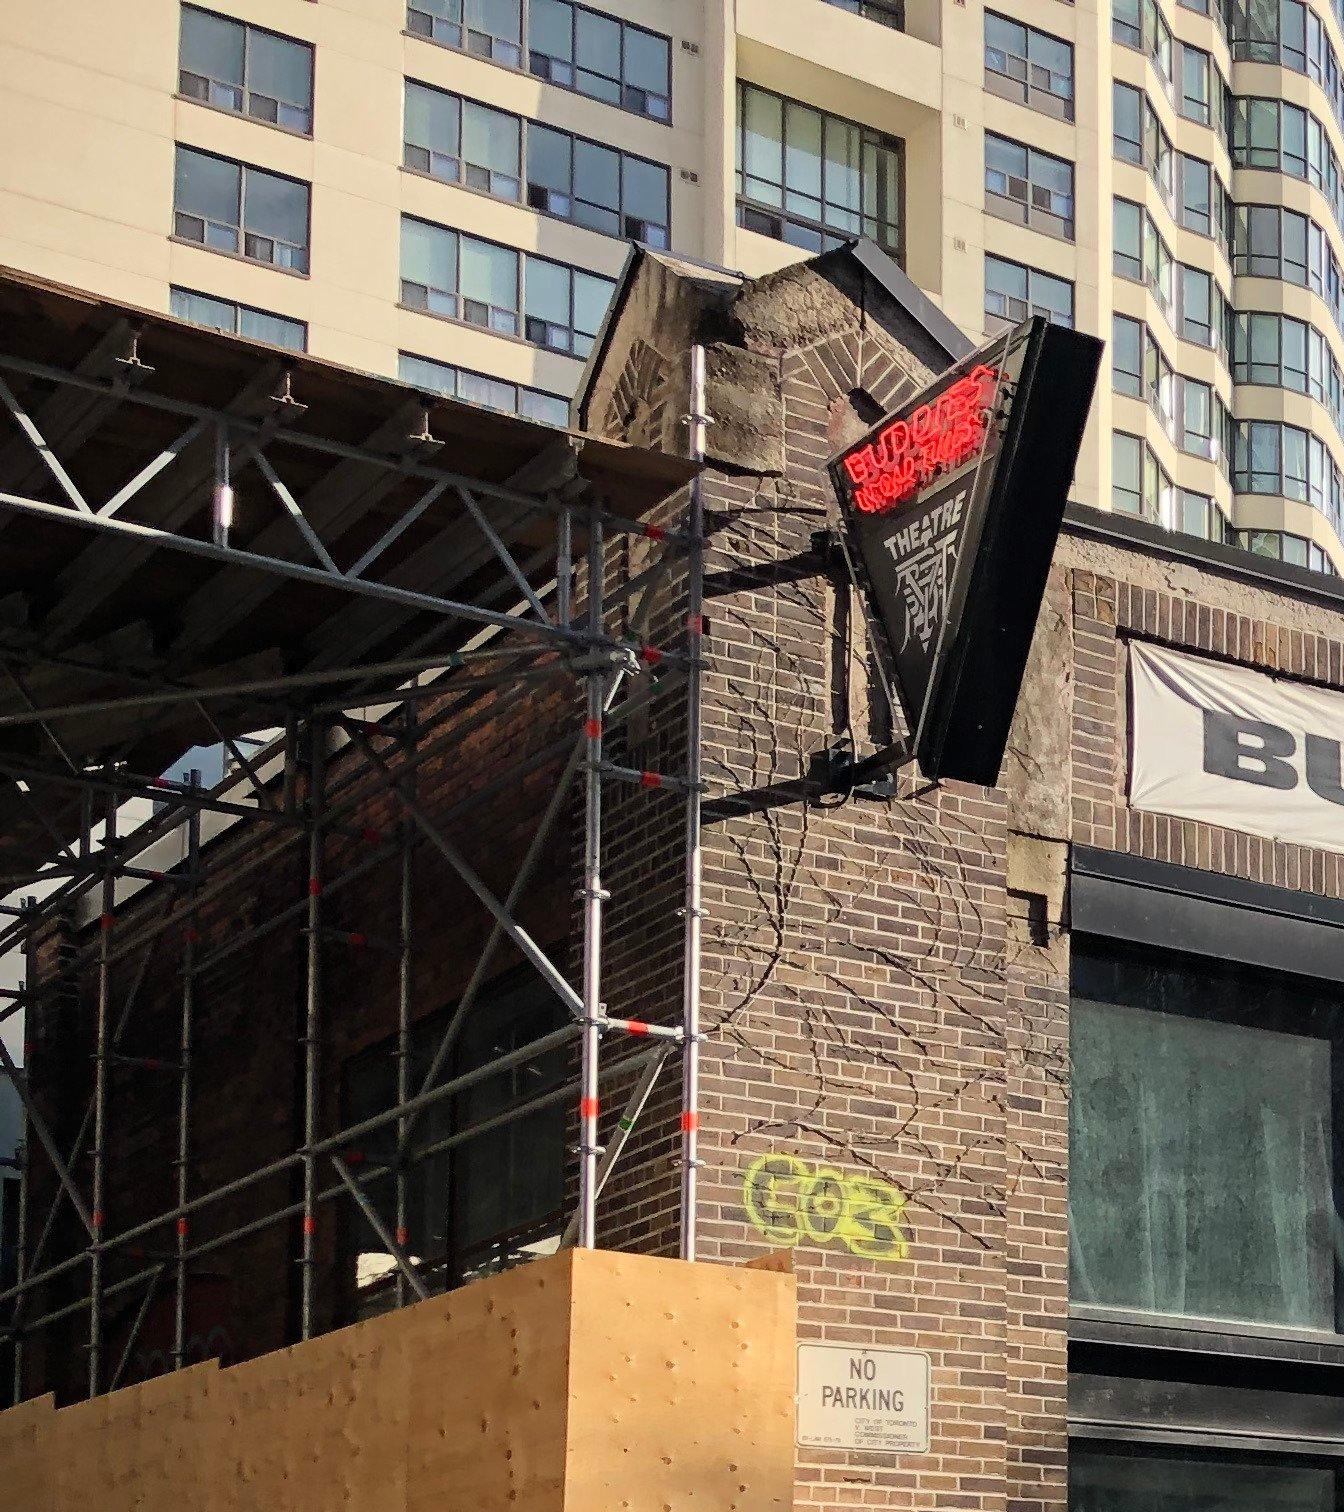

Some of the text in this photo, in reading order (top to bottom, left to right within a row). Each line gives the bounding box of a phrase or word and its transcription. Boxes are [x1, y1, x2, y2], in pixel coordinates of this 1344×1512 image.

[883, 490, 967, 560] THEATRE
[850, 1358, 876, 1380] NO
[822, 1386, 904, 1412] PARKING
